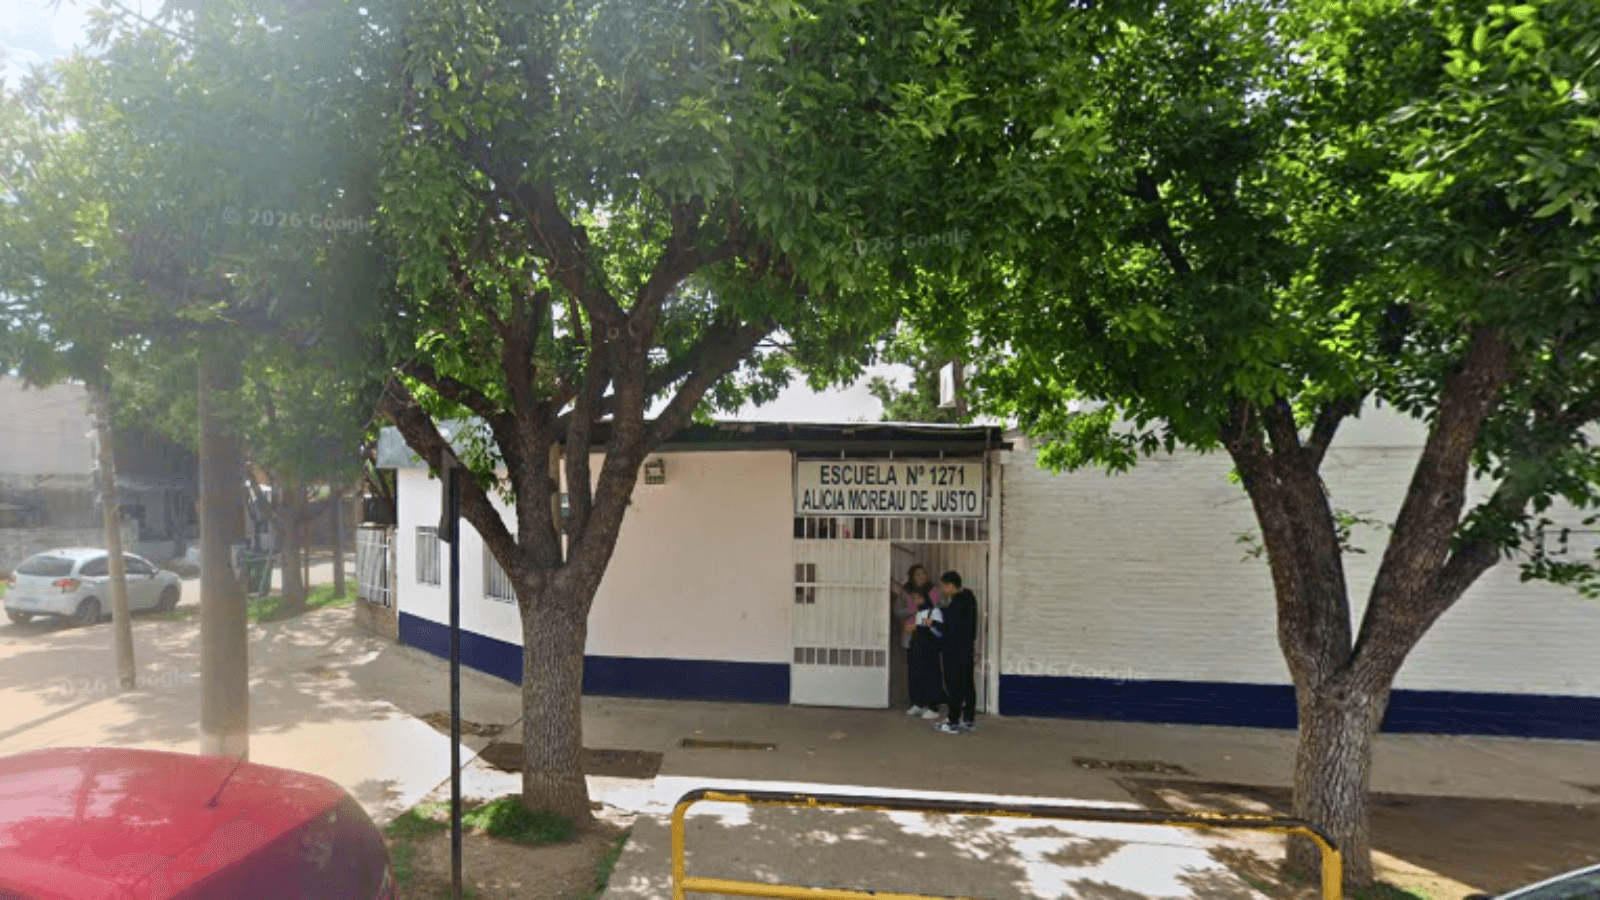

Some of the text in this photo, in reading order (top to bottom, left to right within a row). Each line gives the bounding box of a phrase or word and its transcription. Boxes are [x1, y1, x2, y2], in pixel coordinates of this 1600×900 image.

[820, 465, 897, 485] ESCUELA
[929, 465, 965, 486] 1271
[802, 489, 976, 512] ALICIA MOREAU DE JUSTO
